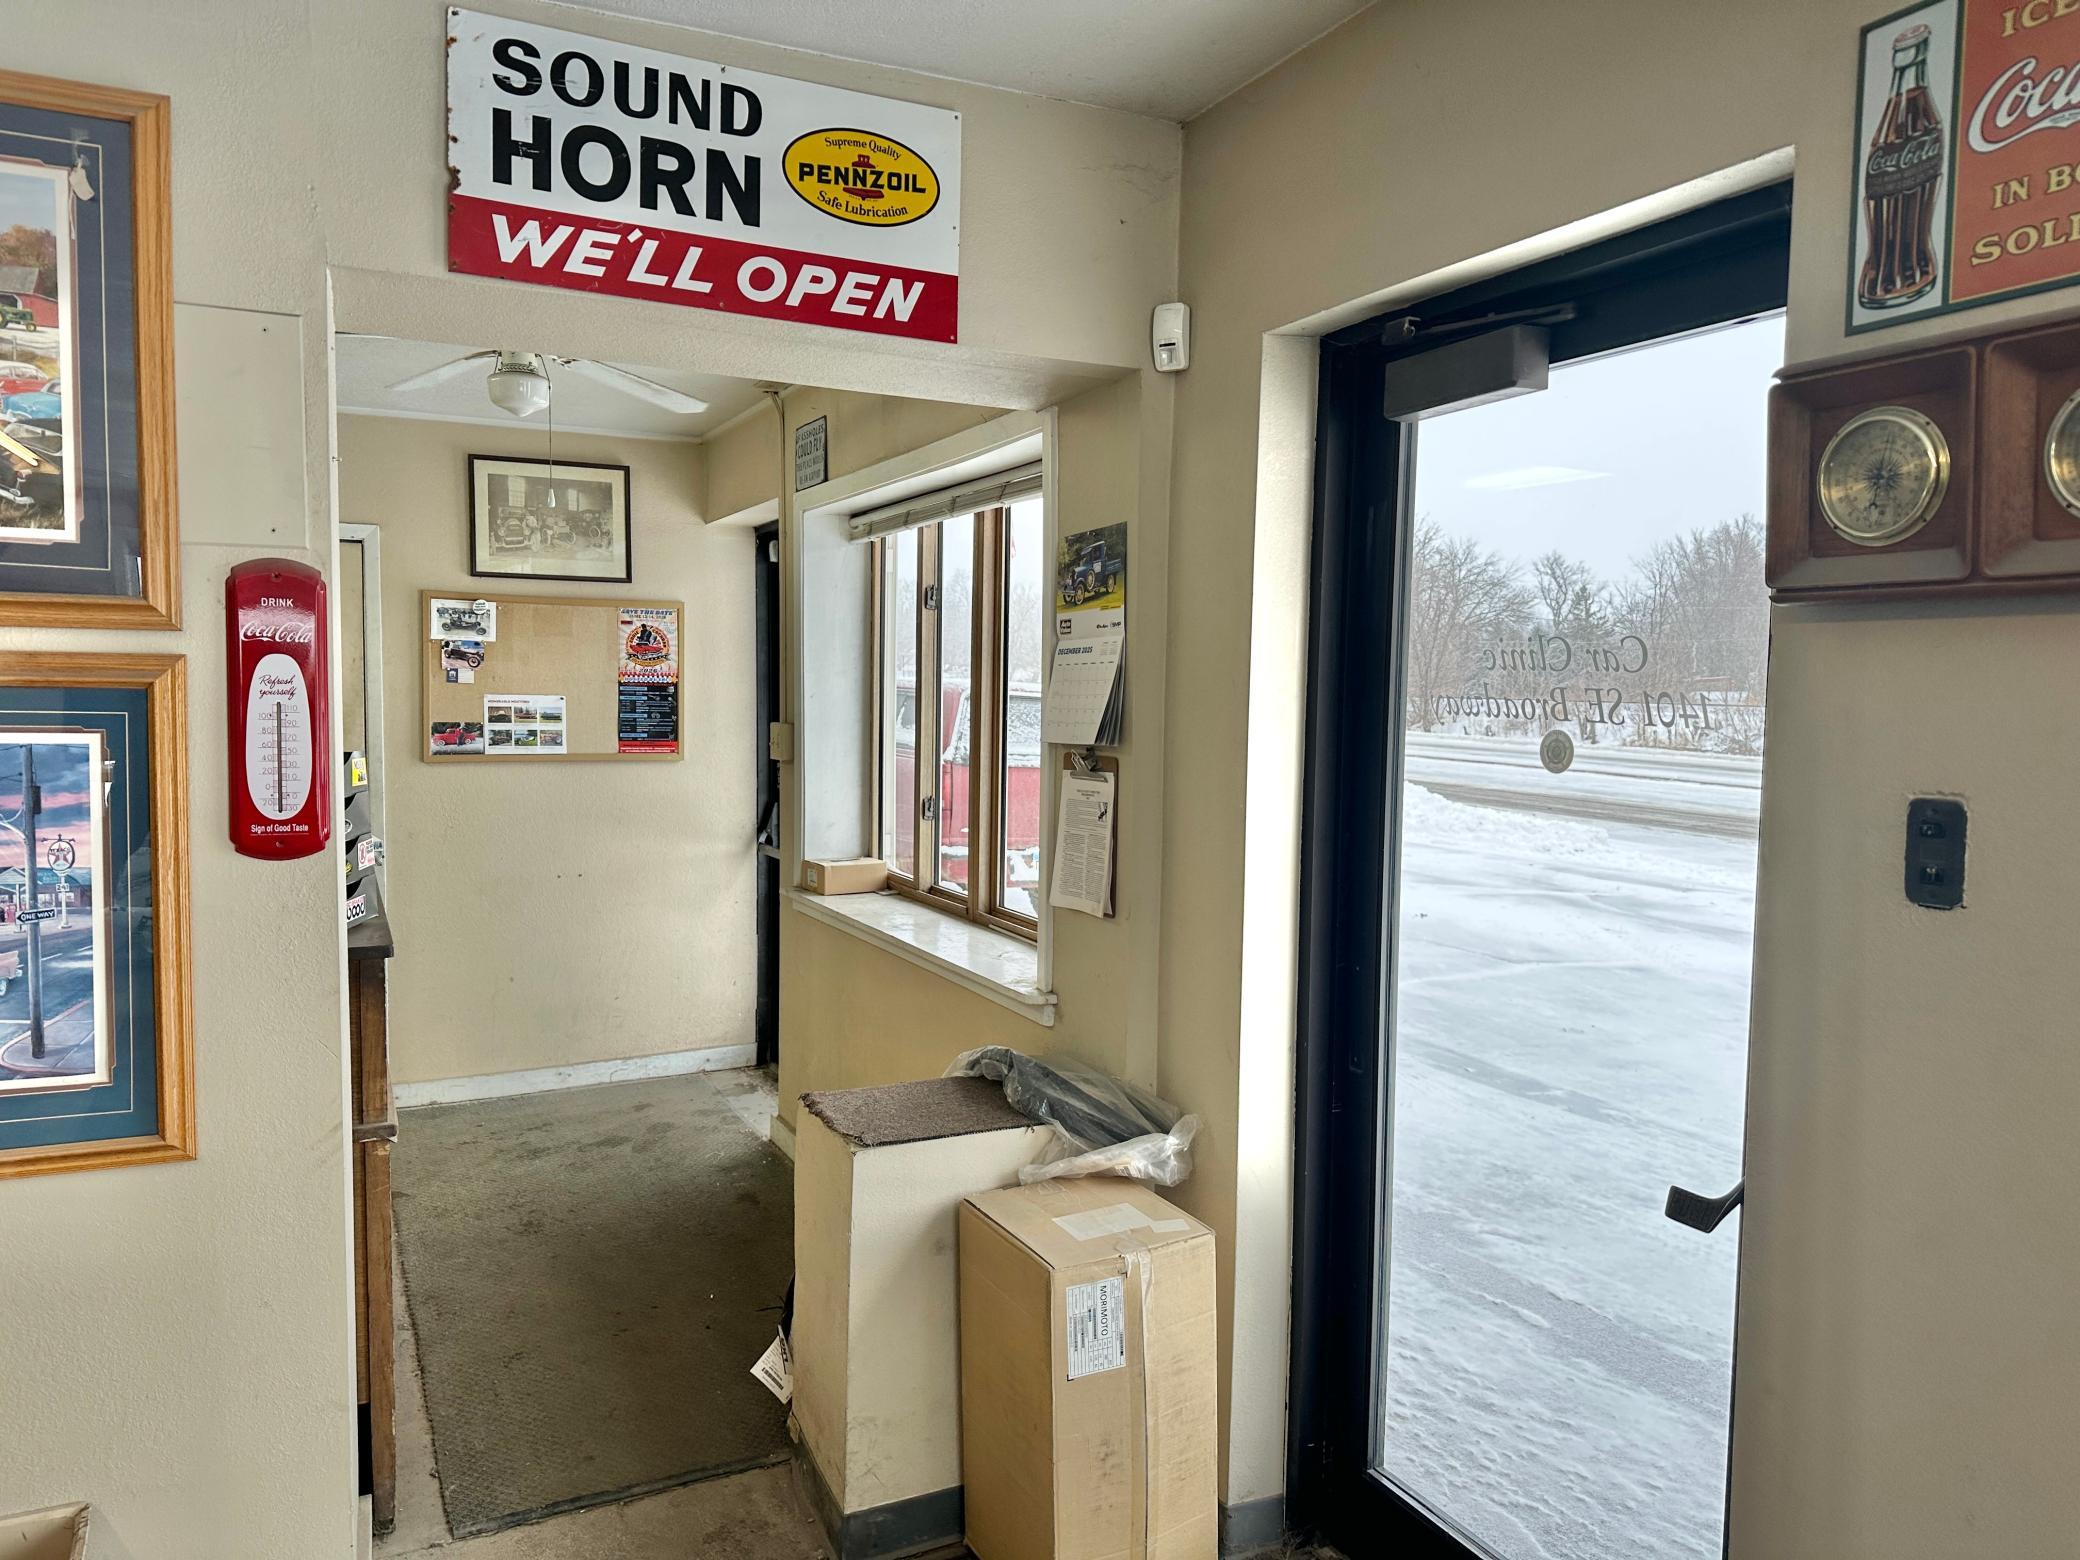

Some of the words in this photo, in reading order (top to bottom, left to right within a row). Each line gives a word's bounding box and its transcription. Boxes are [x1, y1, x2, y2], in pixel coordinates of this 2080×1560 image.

[492, 38, 762, 137] SOUND
[824, 136, 867, 149] Supreme
[868, 139, 901, 160] Quality
[492, 107, 761, 227] HORN
[798, 162, 926, 194] PENNZOIL
[1993, 176, 2029, 209] IN
[2046, 161, 2080, 194] B
[817, 190, 843, 210] Safe
[845, 200, 908, 218] Lubrication
[491, 214, 714, 293] WE'LL
[737, 256, 925, 322] OPEN
[261, 597, 294, 607] DRINK
[240, 621, 314, 643] Coca-Cola
[1057, 647, 1081, 656] DECEMBER
[259, 674, 295, 689] Refresh
[259, 686, 297, 701] yourself
[251, 824, 266, 834] Sign
[266, 824, 273, 832] of
[274, 824, 291, 832] Good
[292, 824, 309, 832] Taste
[20, 913, 36, 921] ONE
[37, 911, 54, 919] WAY
[1099, 1285, 1109, 1337] MORIMOTO
